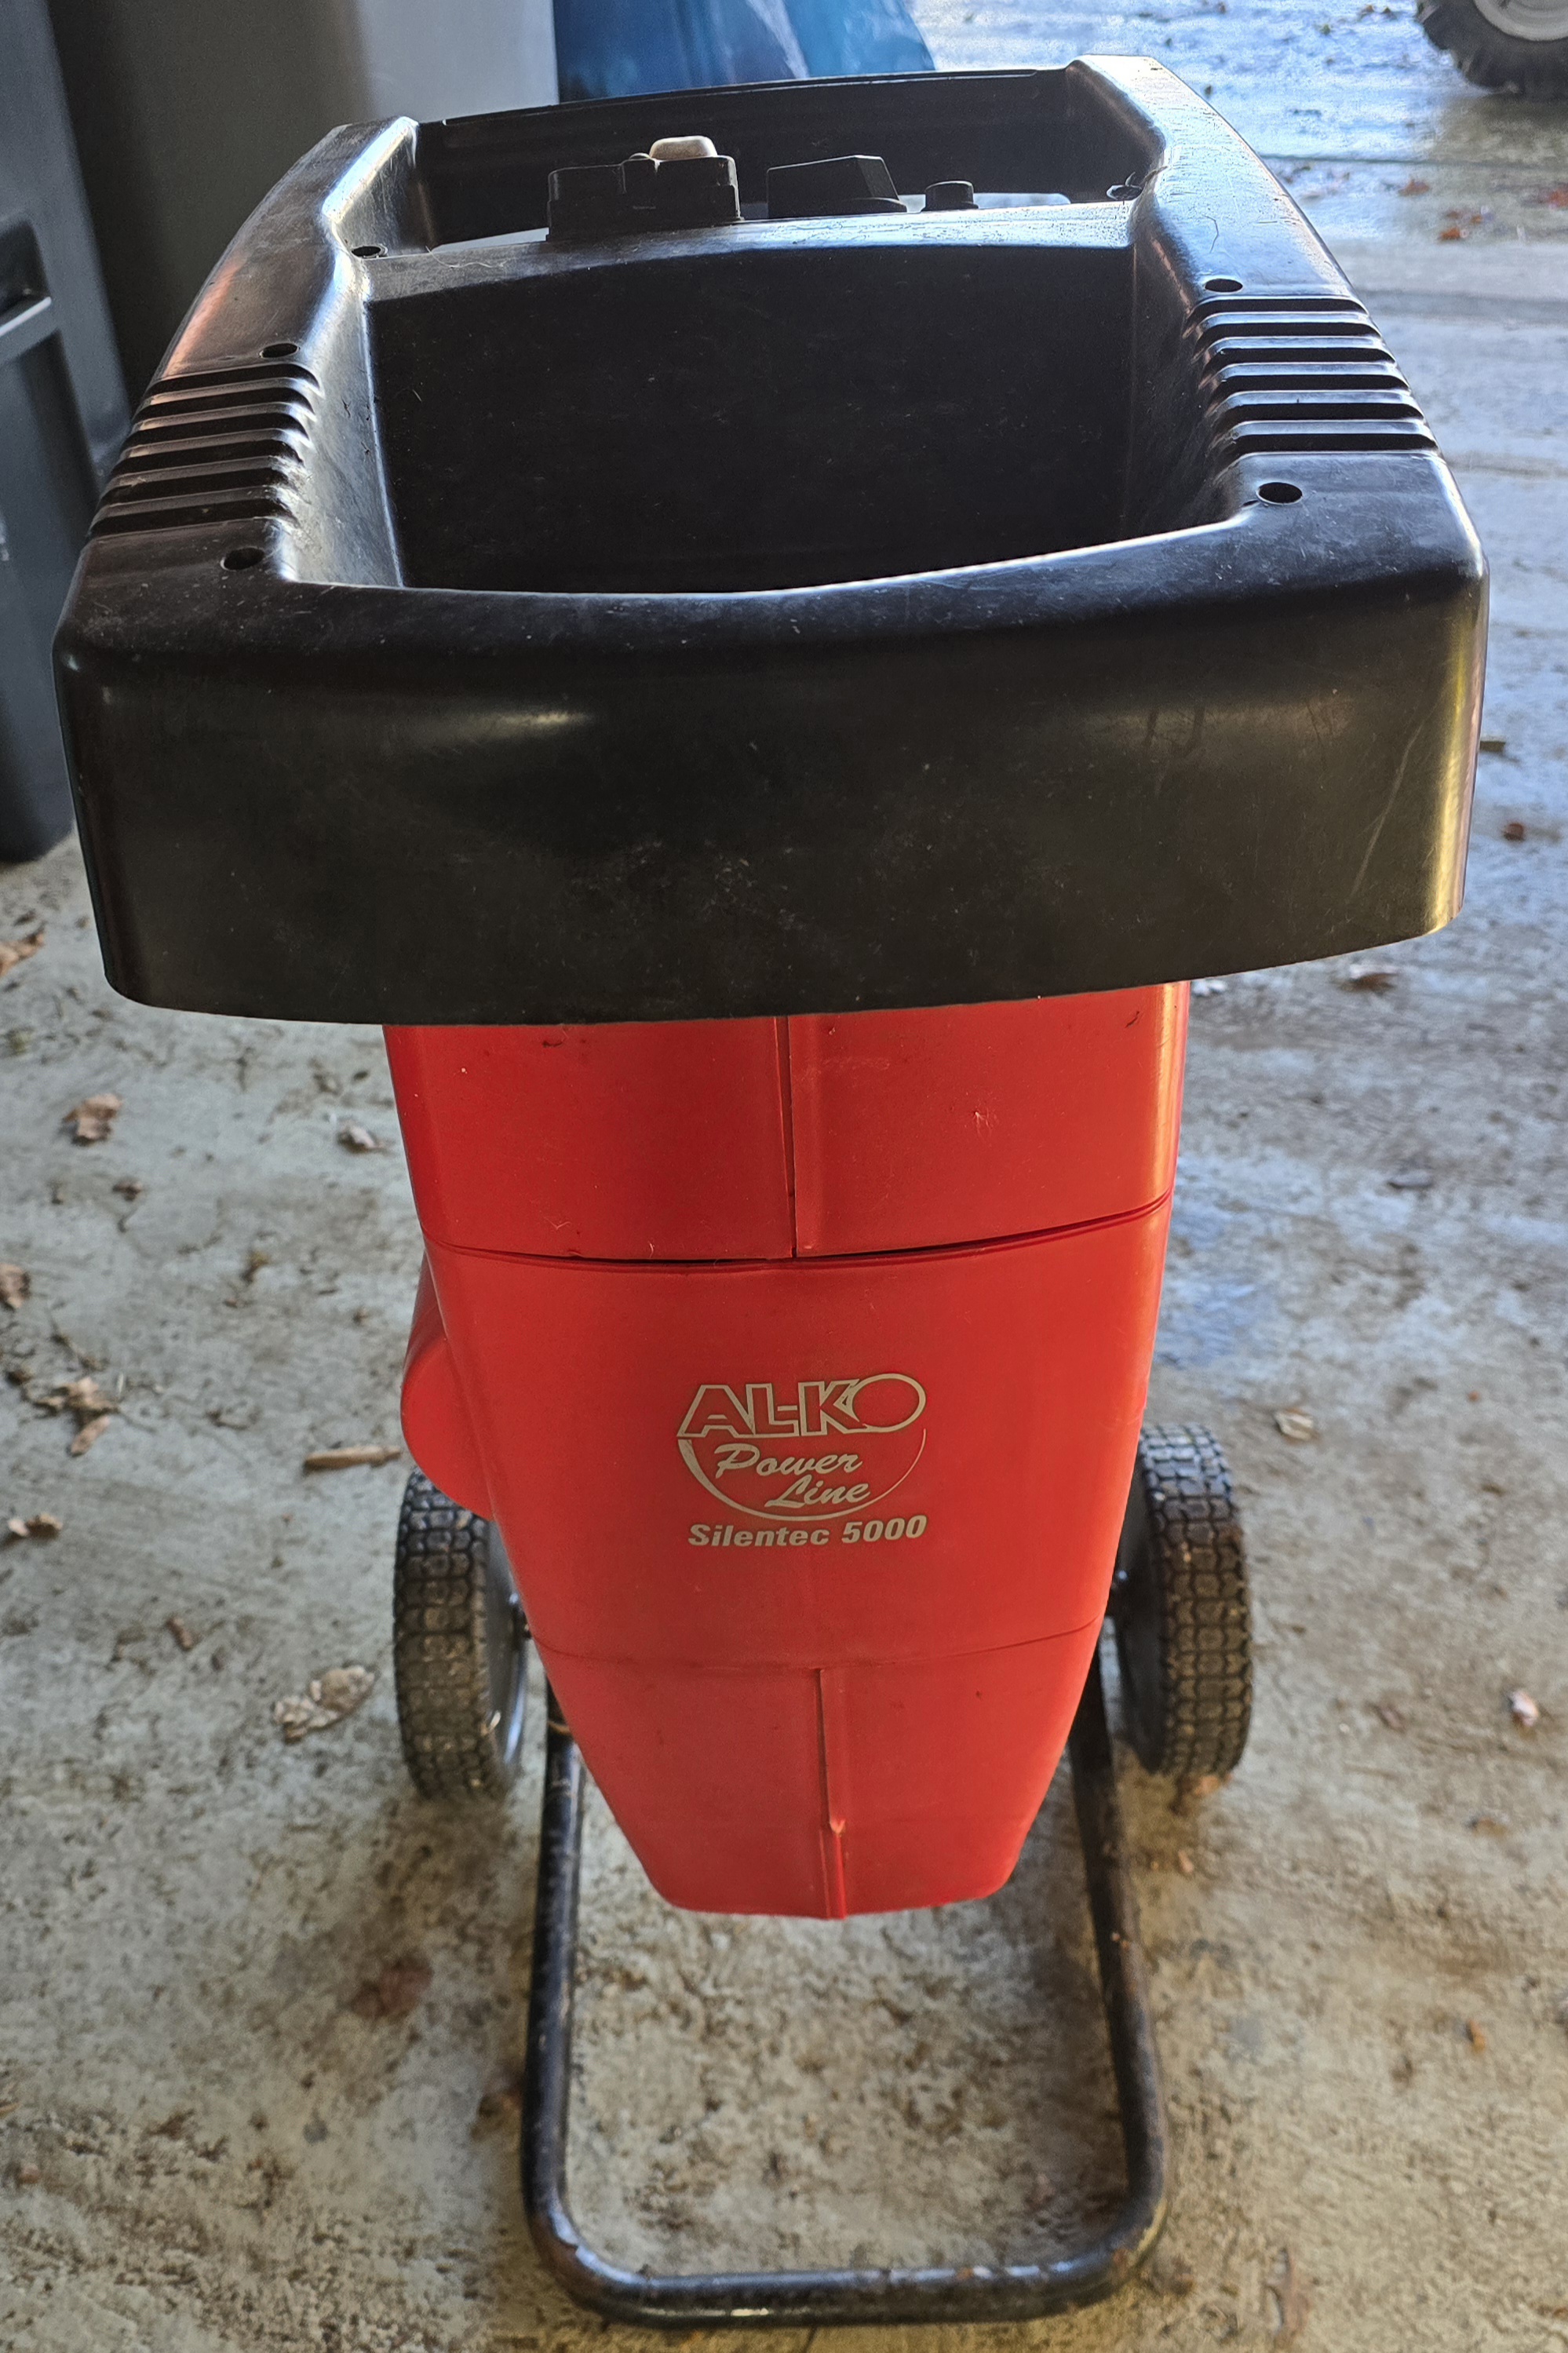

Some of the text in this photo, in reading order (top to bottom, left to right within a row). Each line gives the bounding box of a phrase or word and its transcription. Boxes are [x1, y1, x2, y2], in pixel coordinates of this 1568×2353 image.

[676, 1373, 927, 1439] AL-KO
[714, 1443, 863, 1479] Power
[764, 1474, 871, 1508] Line
[687, 1515, 928, 1547] Silentec 5000
